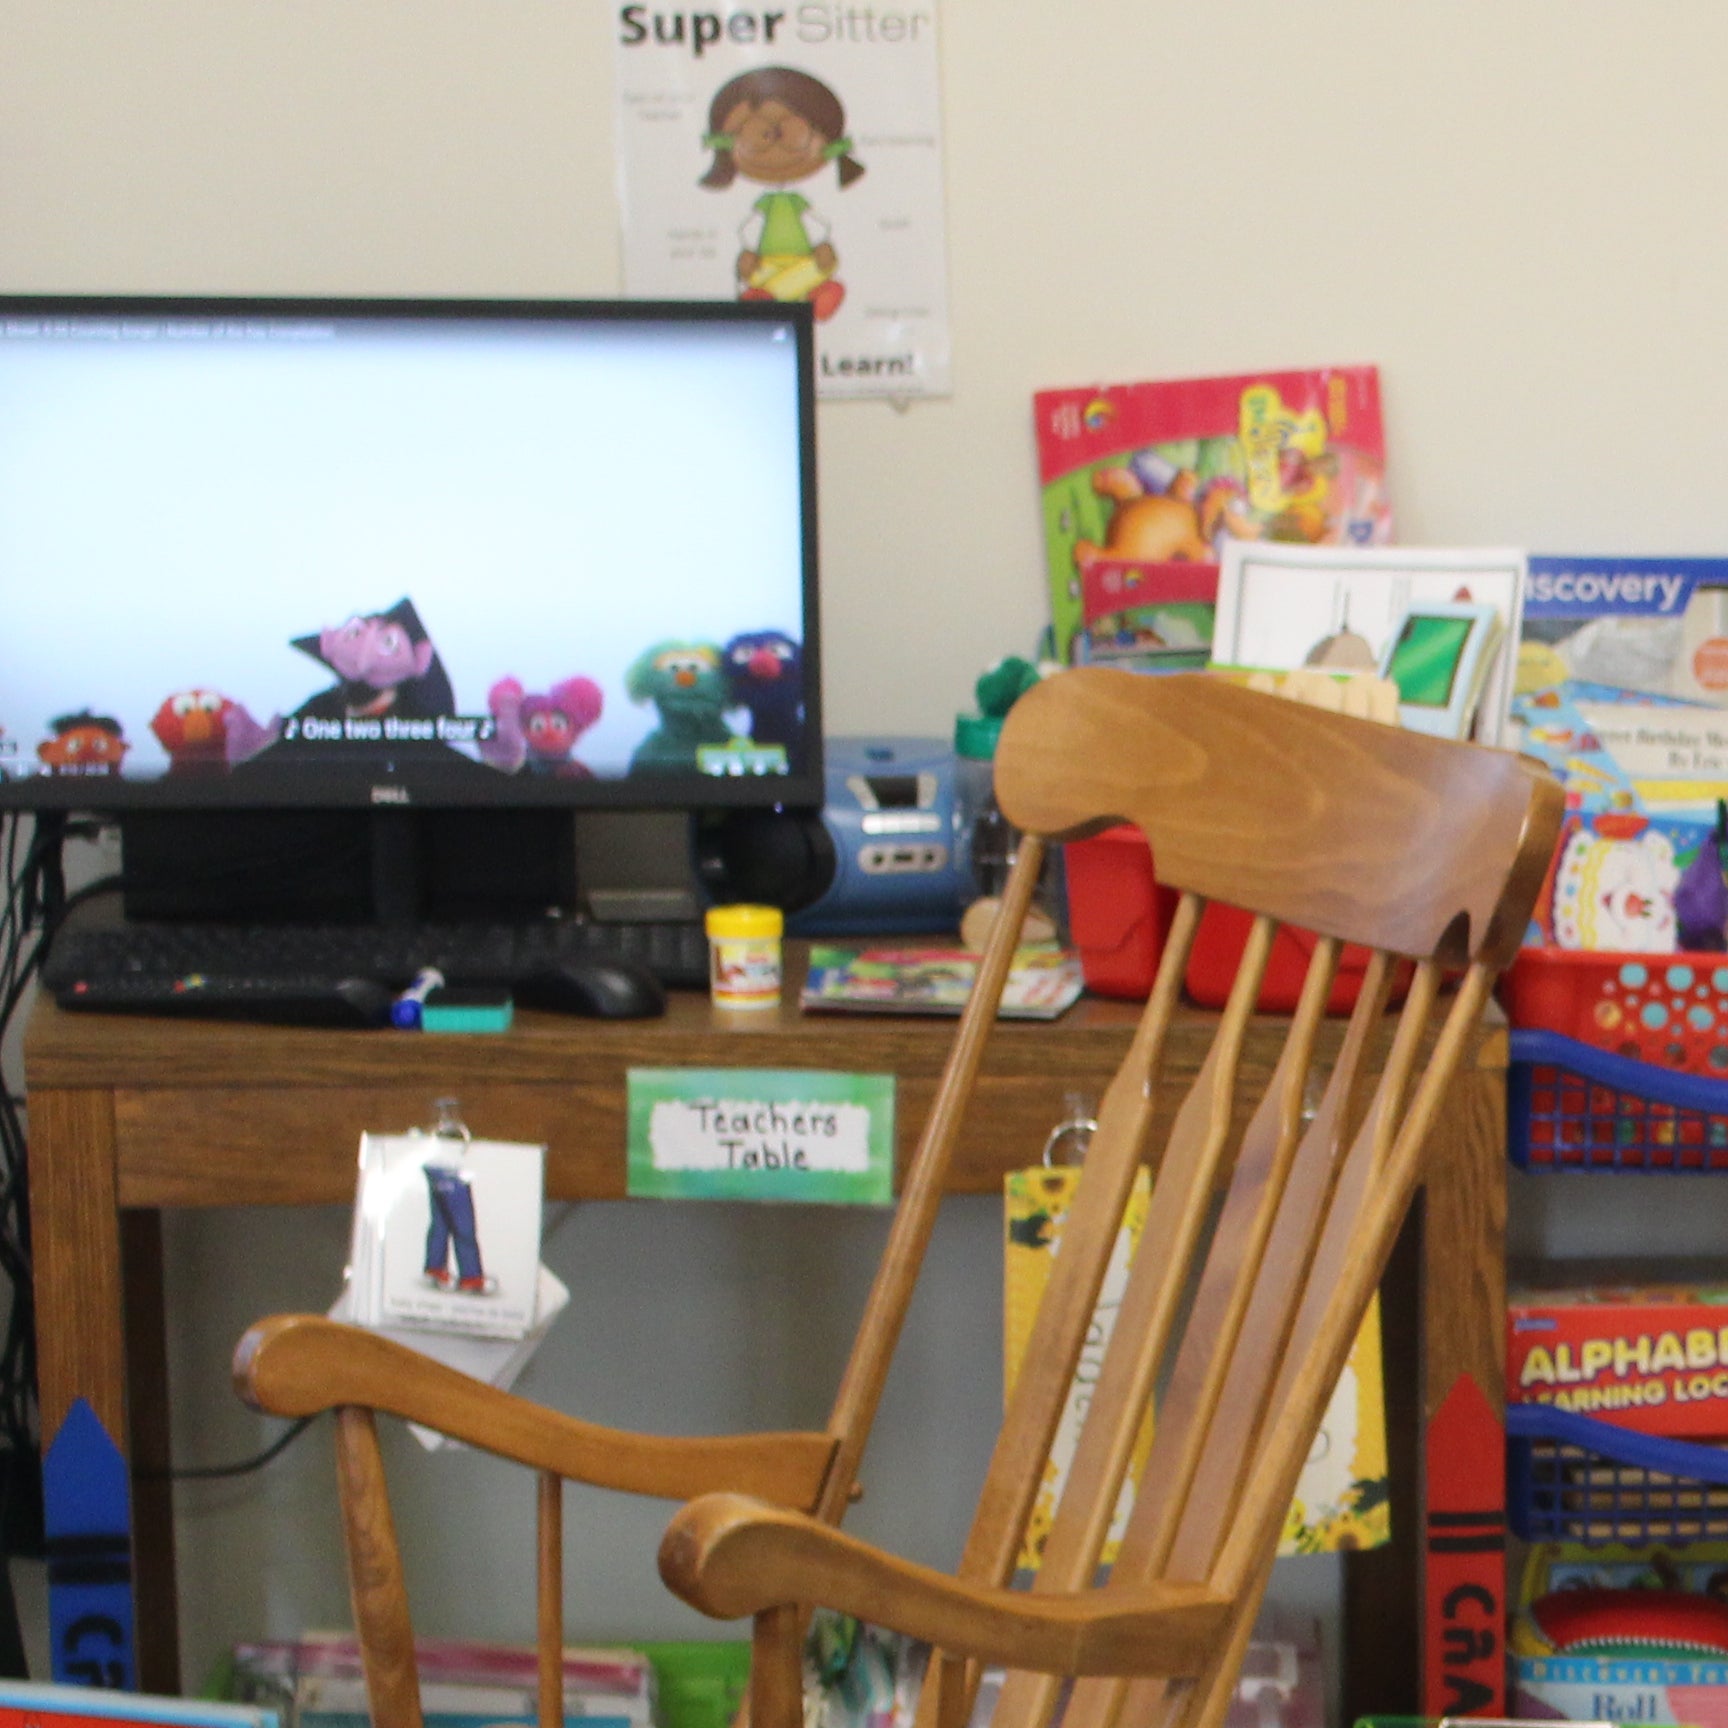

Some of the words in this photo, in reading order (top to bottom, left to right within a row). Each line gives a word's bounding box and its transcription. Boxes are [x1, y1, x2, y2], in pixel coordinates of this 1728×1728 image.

[620, 5, 785, 58] Super
[797, 3, 929, 43] Sitter
[820, 353, 915, 378] Learn!
[302, 715, 342, 740] One
[344, 717, 382, 740] two
[384, 715, 434, 740] three
[436, 714, 476, 740] four
[688, 1103, 838, 1137] Teachers
[718, 1139, 811, 1171] Table
[1533, 1660, 1677, 1682] Discovery
